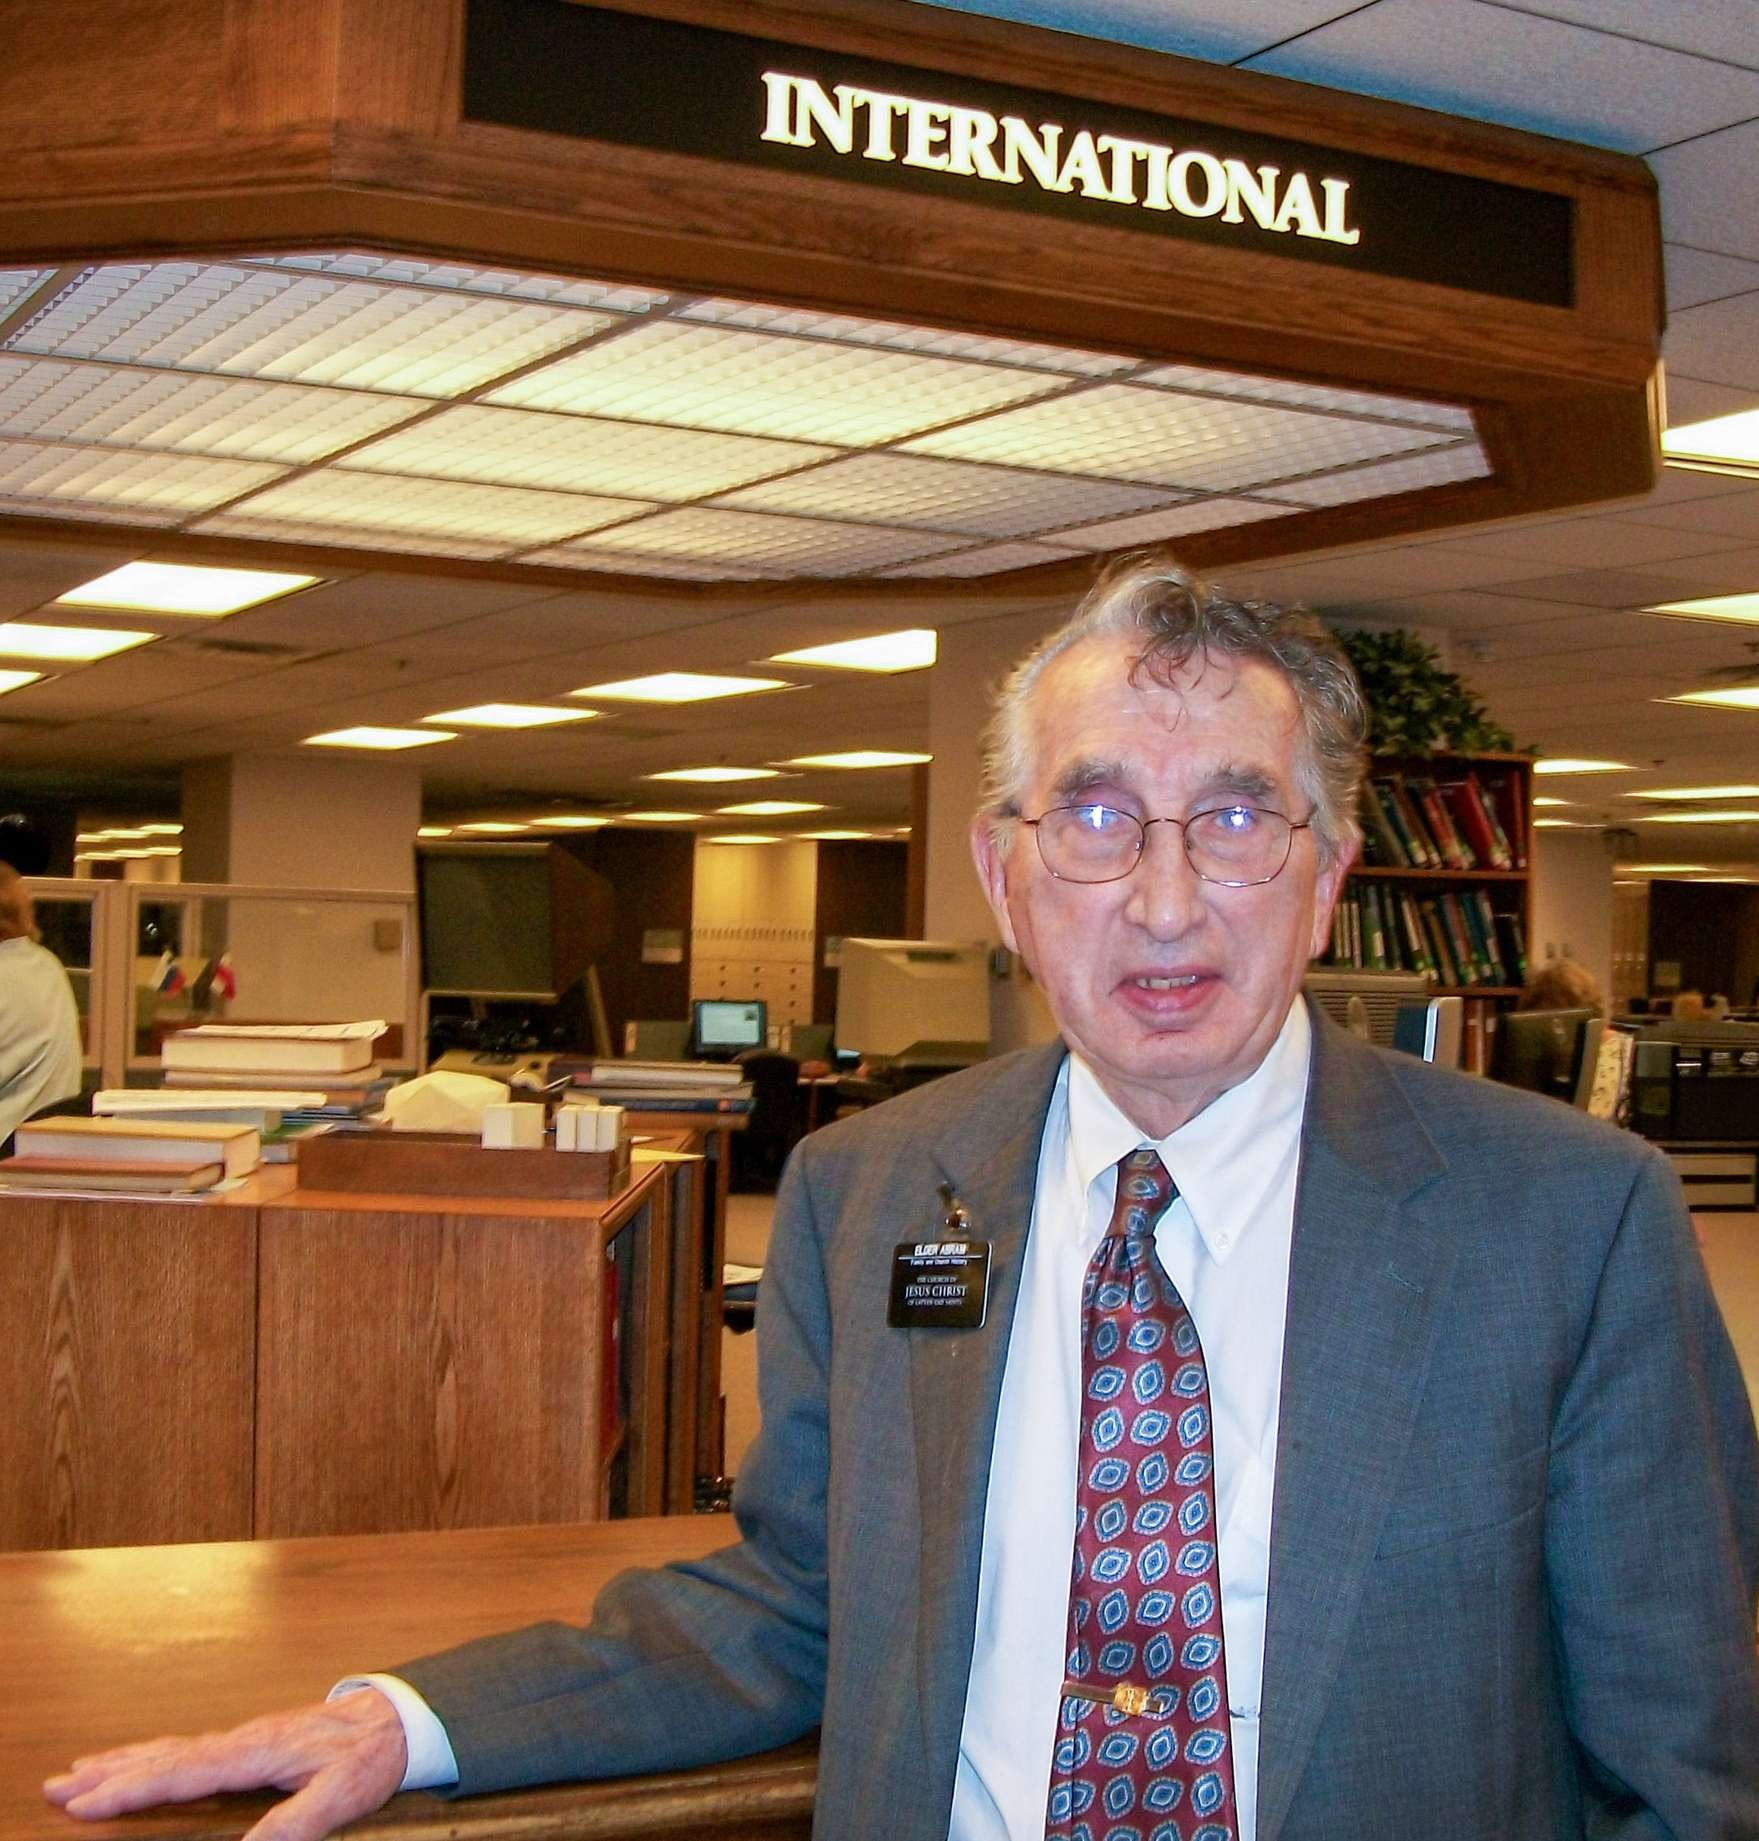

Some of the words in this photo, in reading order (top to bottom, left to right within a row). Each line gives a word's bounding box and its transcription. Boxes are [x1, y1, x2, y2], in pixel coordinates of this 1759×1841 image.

[760, 72, 1360, 244] INTERNATIONAL
[914, 1244, 938, 1256] ELDER
[905, 1286, 930, 1298] JESUS
[932, 1286, 967, 1297] CHRIST
